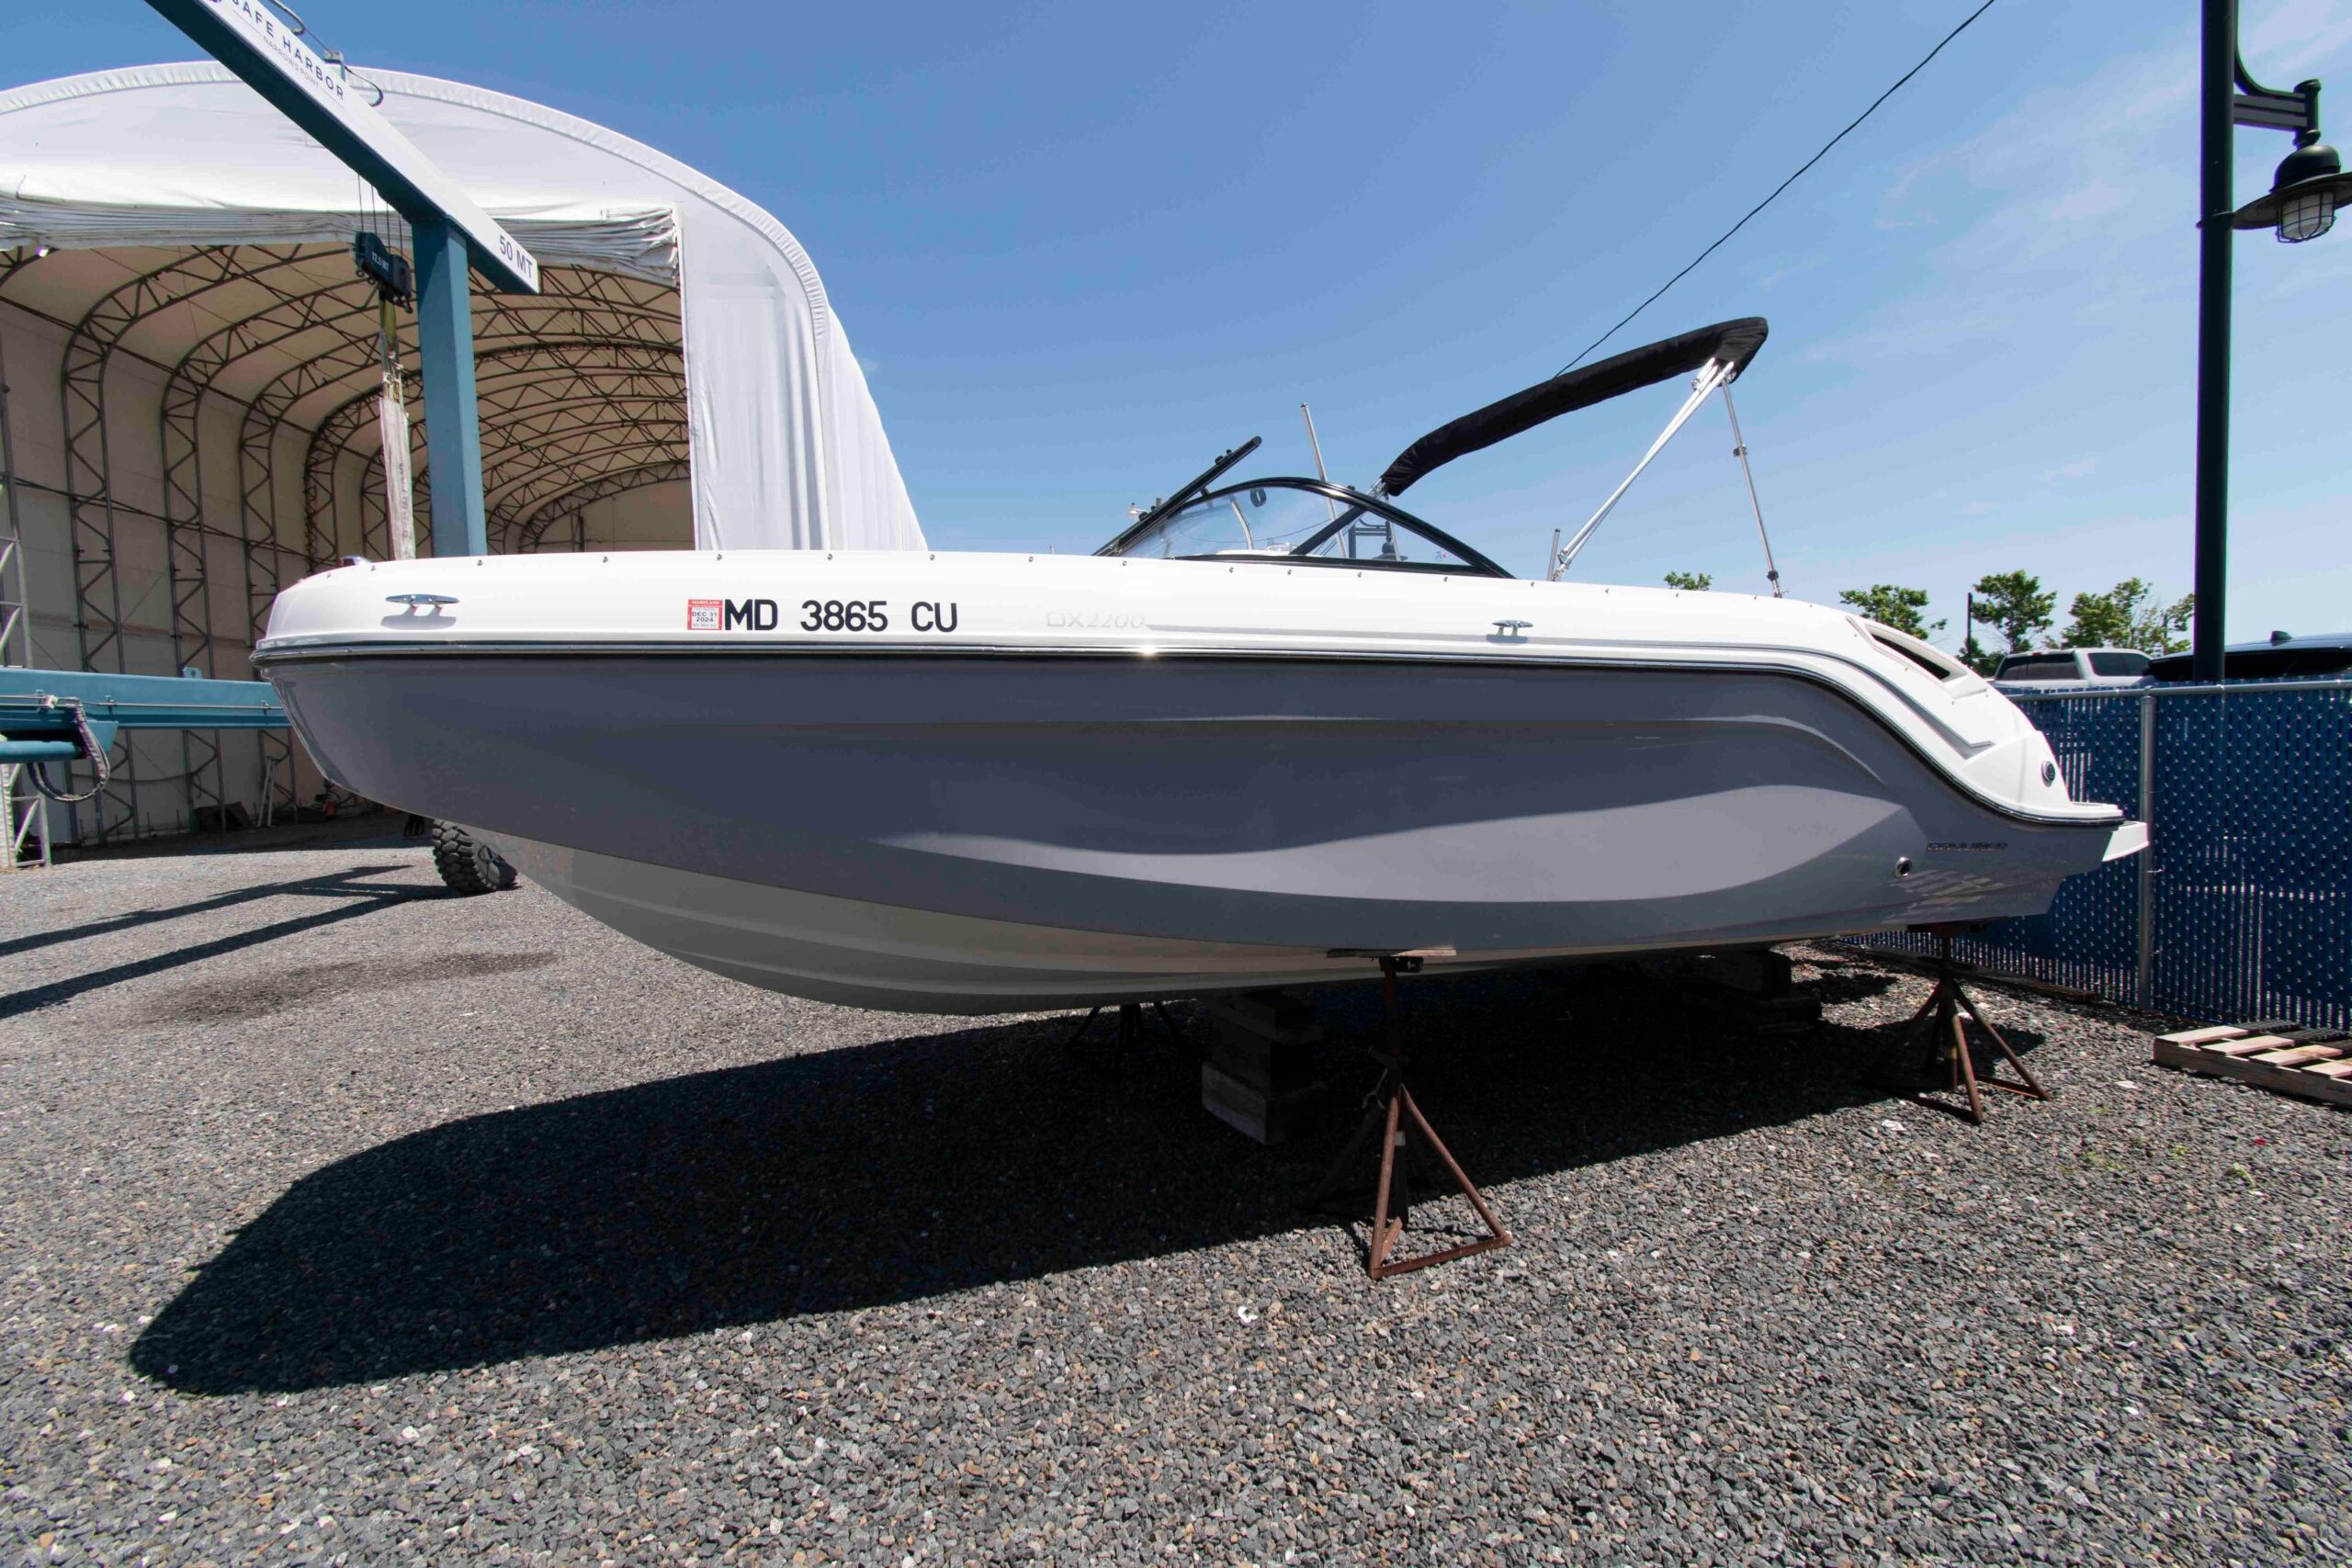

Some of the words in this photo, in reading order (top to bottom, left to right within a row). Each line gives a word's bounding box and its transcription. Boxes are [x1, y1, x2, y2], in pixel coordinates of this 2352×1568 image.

[263, 35, 299, 71] NARROWS
[300, 67, 320, 88] POINT
[282, 35, 345, 101] HARBOR
[500, 235, 513, 261] 50
[517, 249, 534, 279] MT
[725, 599, 777, 630] MD
[800, 600, 888, 632] 3865
[911, 602, 957, 632] CU
